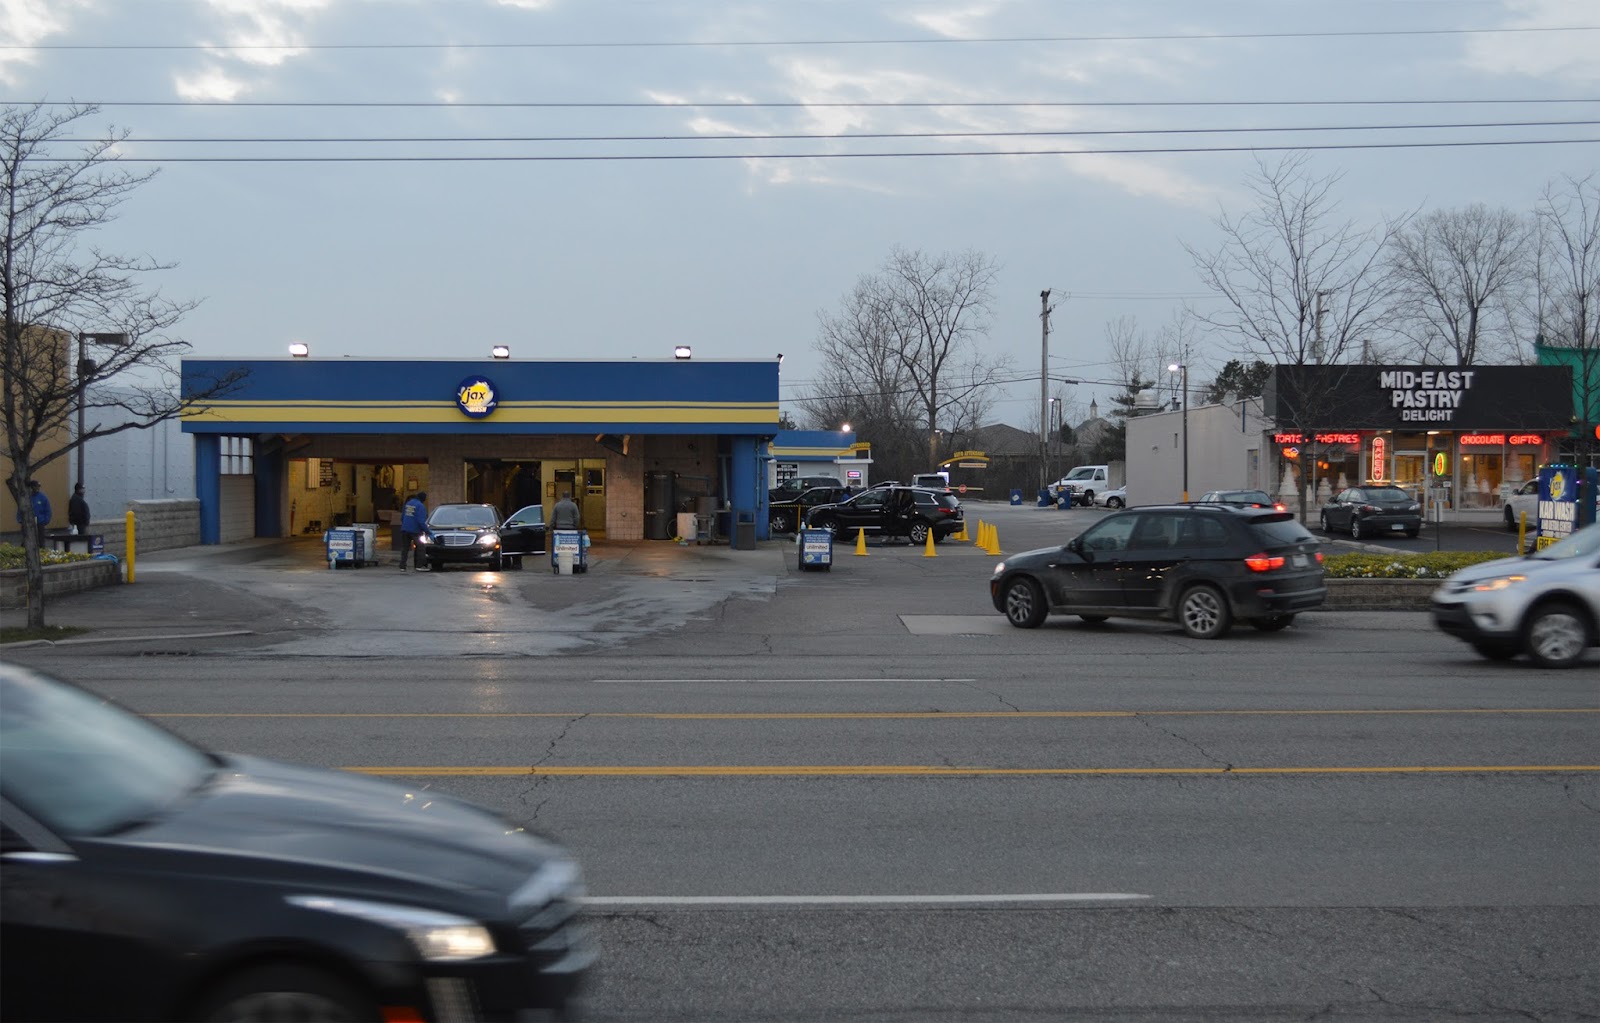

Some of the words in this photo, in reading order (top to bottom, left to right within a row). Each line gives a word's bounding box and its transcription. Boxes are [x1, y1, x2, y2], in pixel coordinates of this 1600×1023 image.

[1380, 371, 1474, 389] MID-EAST
[462, 388, 486, 405] jax
[1392, 390, 1462, 408] PASTRY
[1402, 410, 1453, 421] DELIGHT
[1460, 435, 1504, 445] CHOCOLATE
[1508, 435, 1542, 445] GIFTS
[1374, 439, 1382, 480] BAKERY
[1539, 500, 1554, 519] KAR
[1554, 501, 1575, 521] WASH
